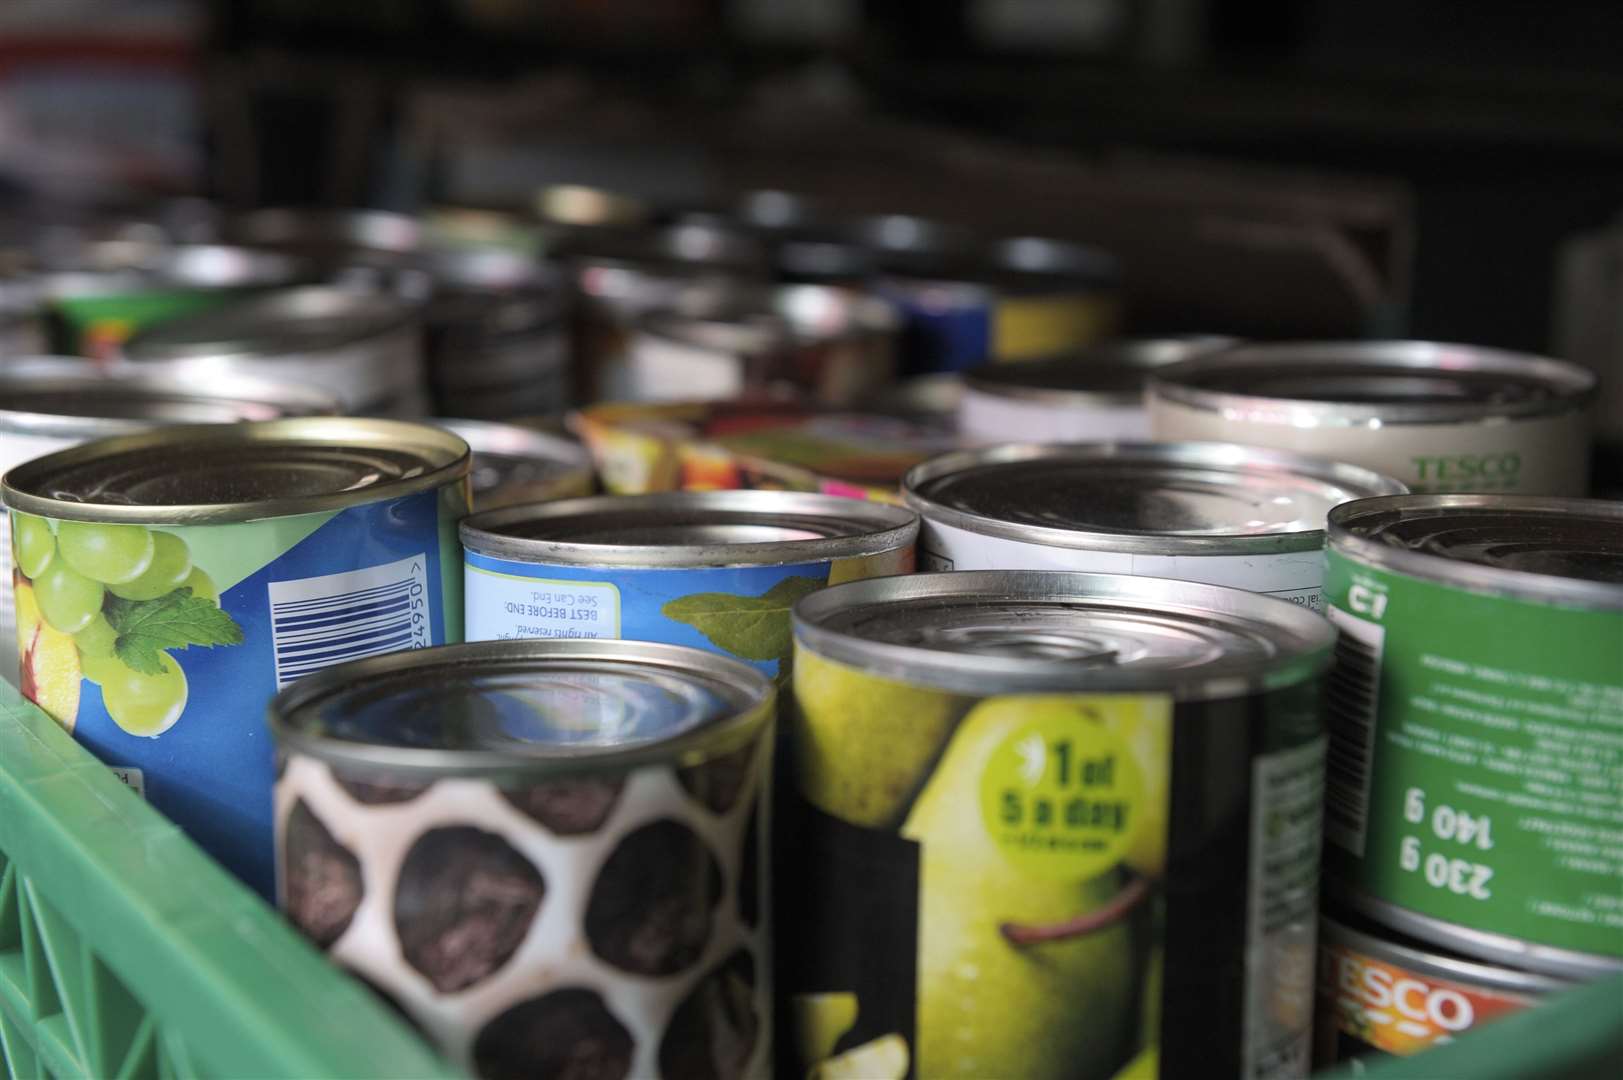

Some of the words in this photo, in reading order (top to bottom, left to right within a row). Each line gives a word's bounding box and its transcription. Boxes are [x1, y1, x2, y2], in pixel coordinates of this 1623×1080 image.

[1411, 451, 1522, 480] TESCO
[526, 605, 567, 620] BEFORE
[553, 592, 576, 606] Can
[569, 609, 599, 622] BEST
[577, 594, 599, 608] See
[554, 627, 582, 639] rights
[1053, 740, 1072, 788] 1
[1081, 750, 1117, 787] of
[1000, 792, 1022, 825] 5
[1034, 800, 1054, 827] a
[1063, 797, 1130, 834] day
[1403, 787, 1425, 825] g
[1432, 805, 1494, 851] 140
[1400, 834, 1422, 873] g
[1426, 853, 1494, 901] 230
[1336, 954, 1475, 1032] ESCO
